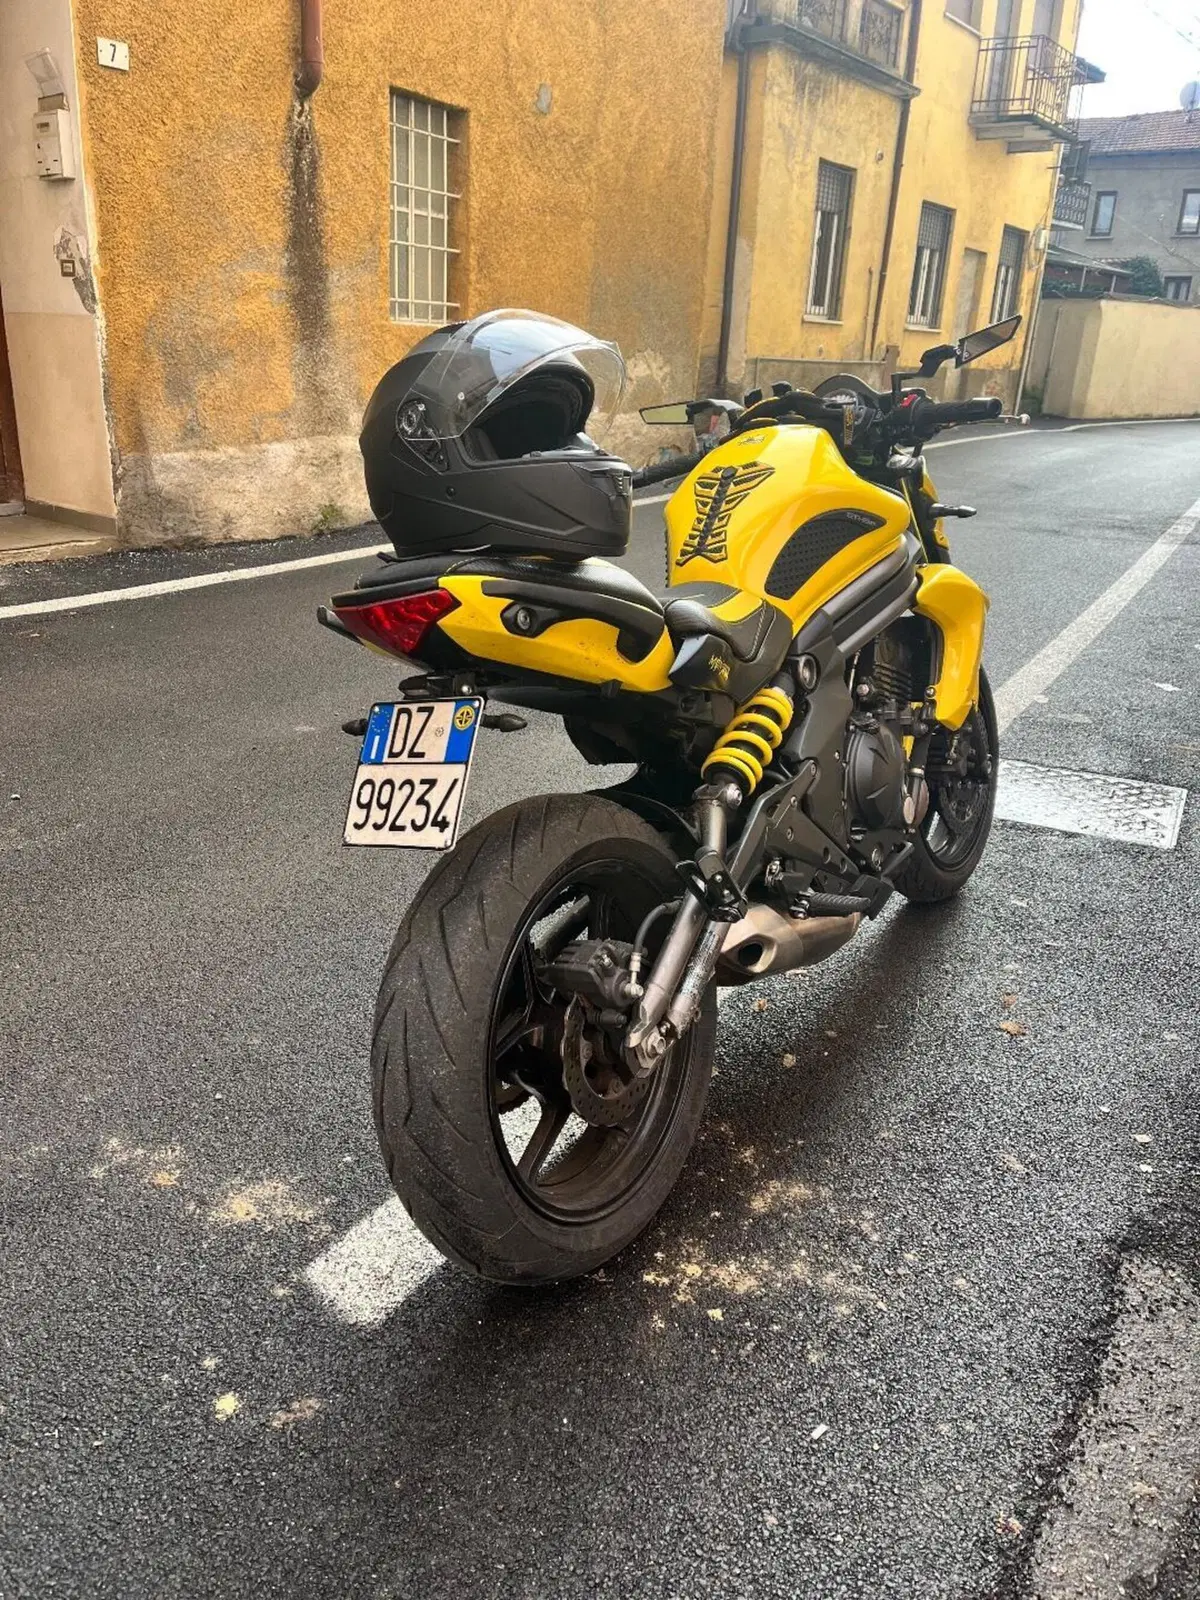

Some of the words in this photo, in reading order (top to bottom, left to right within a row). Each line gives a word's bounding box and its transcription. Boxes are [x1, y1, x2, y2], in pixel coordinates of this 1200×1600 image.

[109, 43, 117, 62] 7
[370, 735, 380, 760] I
[387, 706, 435, 759] DZ
[353, 778, 459, 833] 99234
